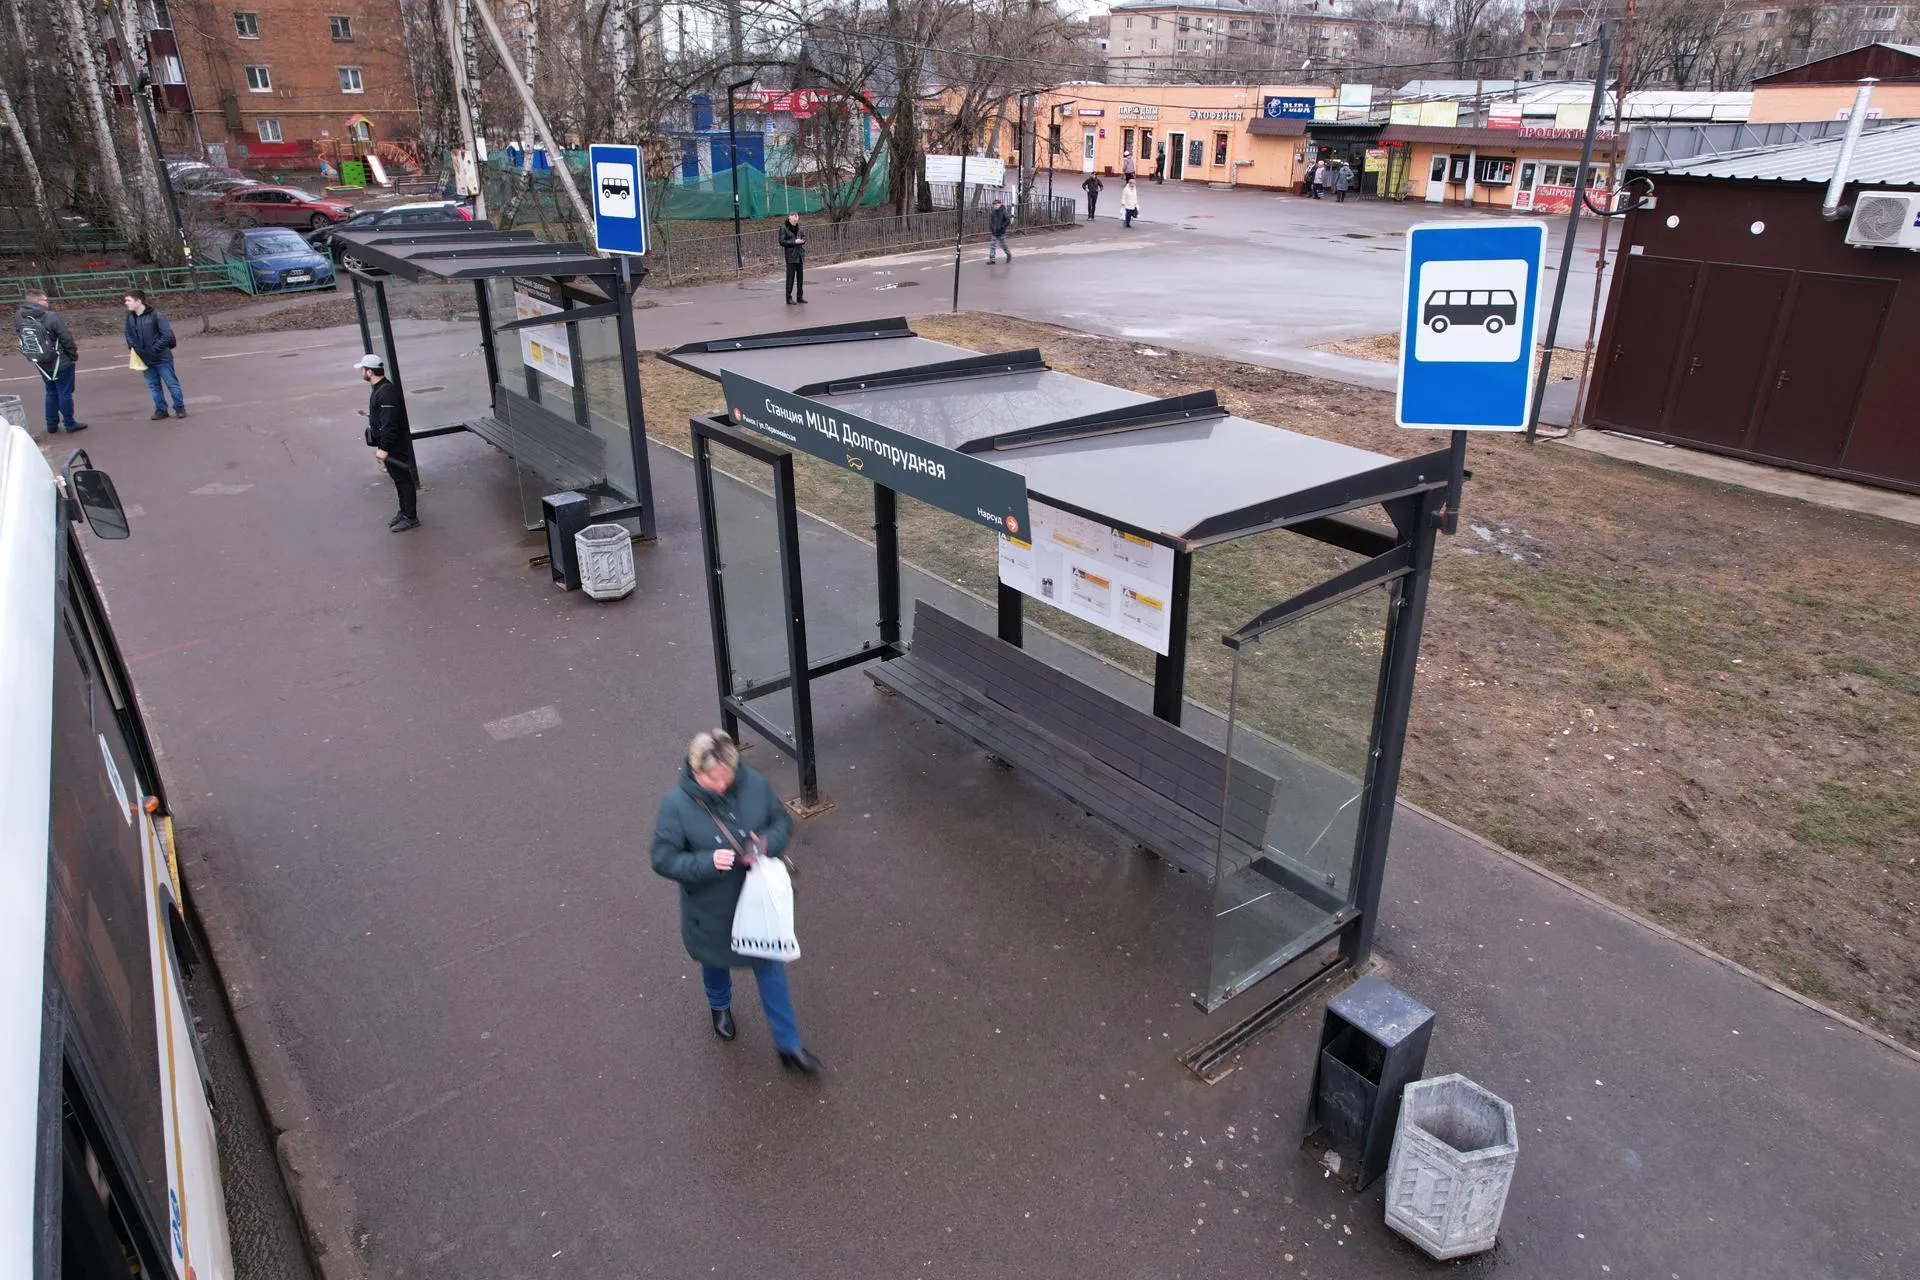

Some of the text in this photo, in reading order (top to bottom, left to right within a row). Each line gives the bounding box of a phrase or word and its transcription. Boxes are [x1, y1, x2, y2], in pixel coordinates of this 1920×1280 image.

[1118, 105, 1158, 115] ПАР ДЫМ
[1282, 102, 1311, 113] РЫБА
[1198, 110, 1243, 121] КОФЕЙНЯ
[765, 399, 946, 480] Станция МЦД Долгопрудная
[977, 507, 1003, 525] Нарсуд
